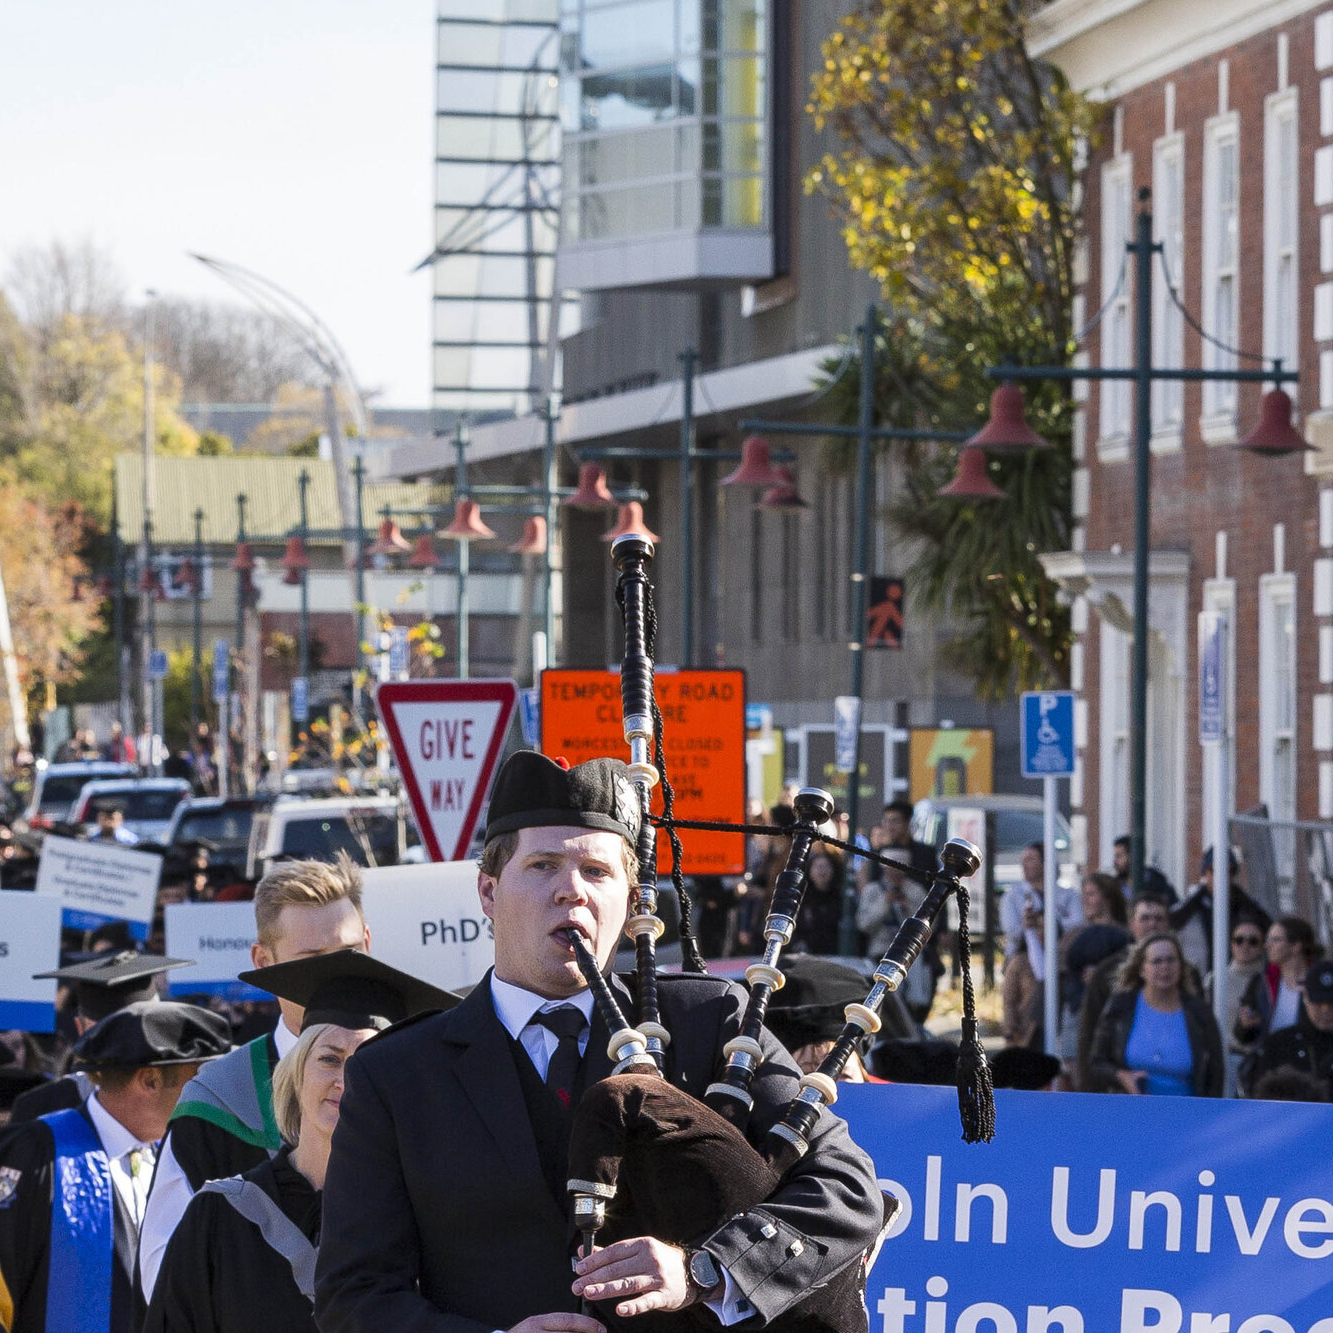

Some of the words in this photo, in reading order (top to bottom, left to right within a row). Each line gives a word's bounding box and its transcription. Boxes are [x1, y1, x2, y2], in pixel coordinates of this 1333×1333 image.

[680, 682, 735, 700] ROAD
[420, 719, 474, 761] GIVE
[430, 780, 466, 811] WAY
